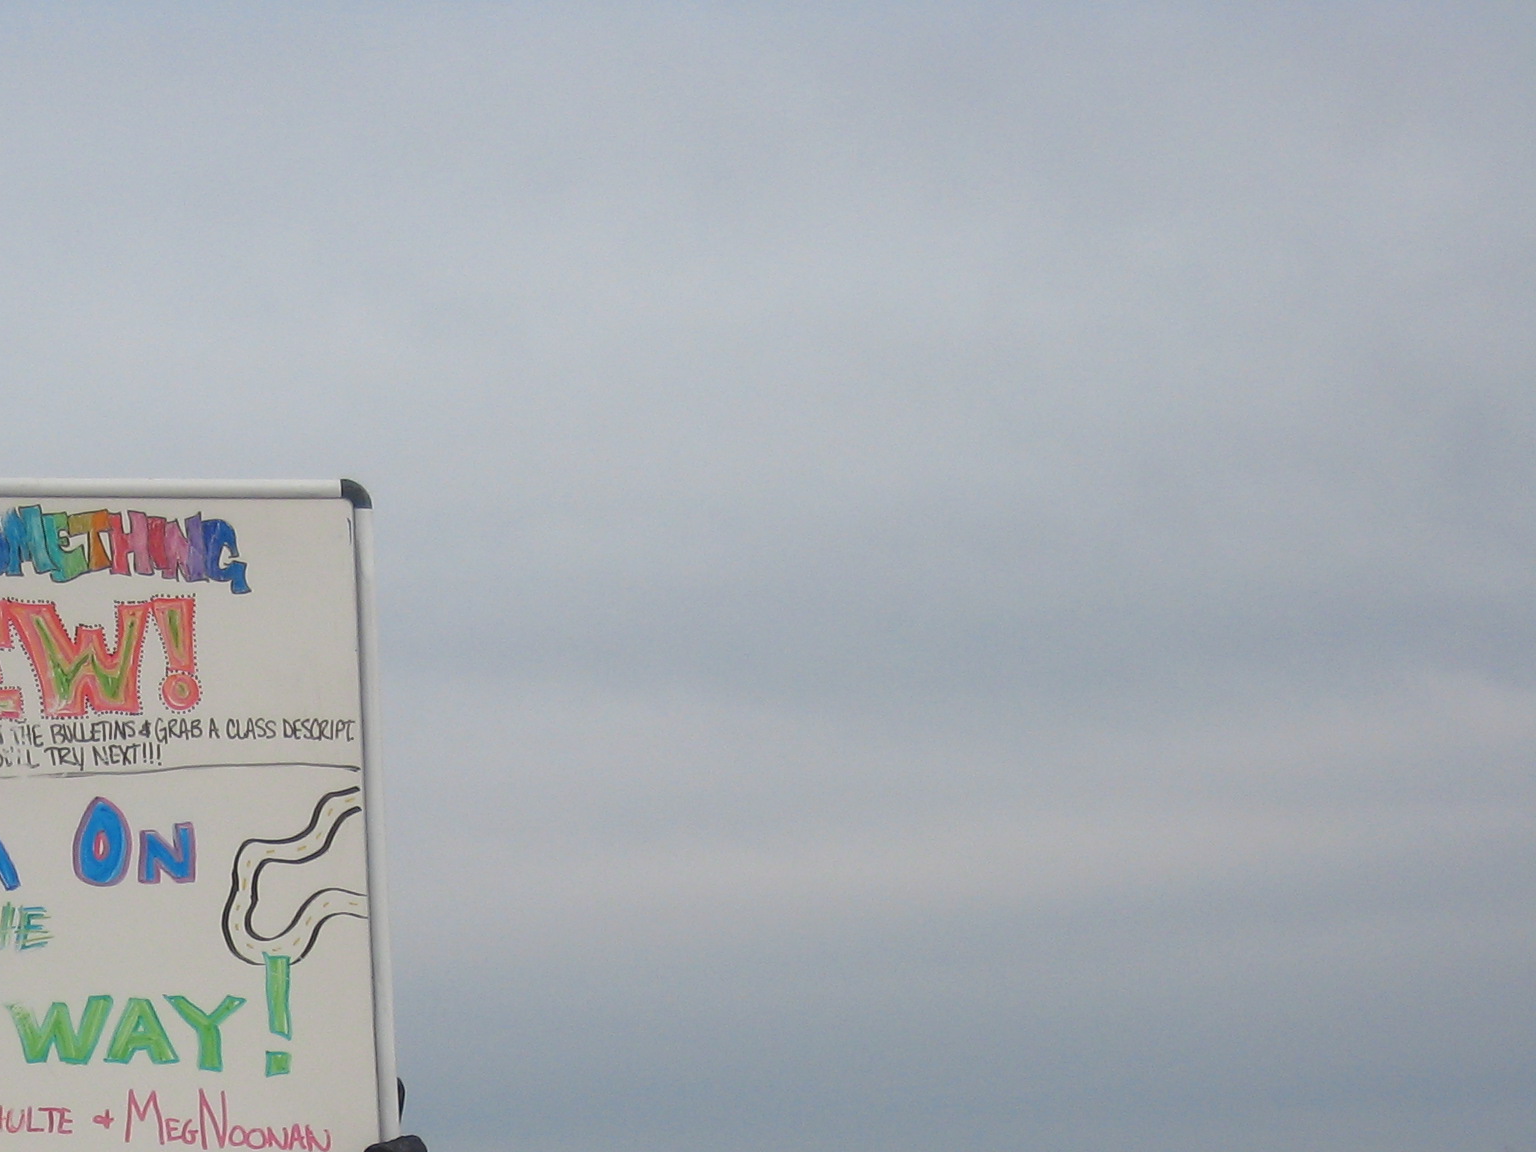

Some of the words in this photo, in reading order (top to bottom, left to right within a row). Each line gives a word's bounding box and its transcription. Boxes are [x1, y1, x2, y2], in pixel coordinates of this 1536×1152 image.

[11, 720, 43, 747] THE
[50, 720, 136, 745] BULLETINS
[155, 718, 202, 744] GRAB
[209, 719, 220, 739] A
[226, 718, 276, 740] CLASS
[44, 747, 84, 771] TRY
[92, 743, 162, 767] NEXT!!!
[73, 797, 196, 886] ON
